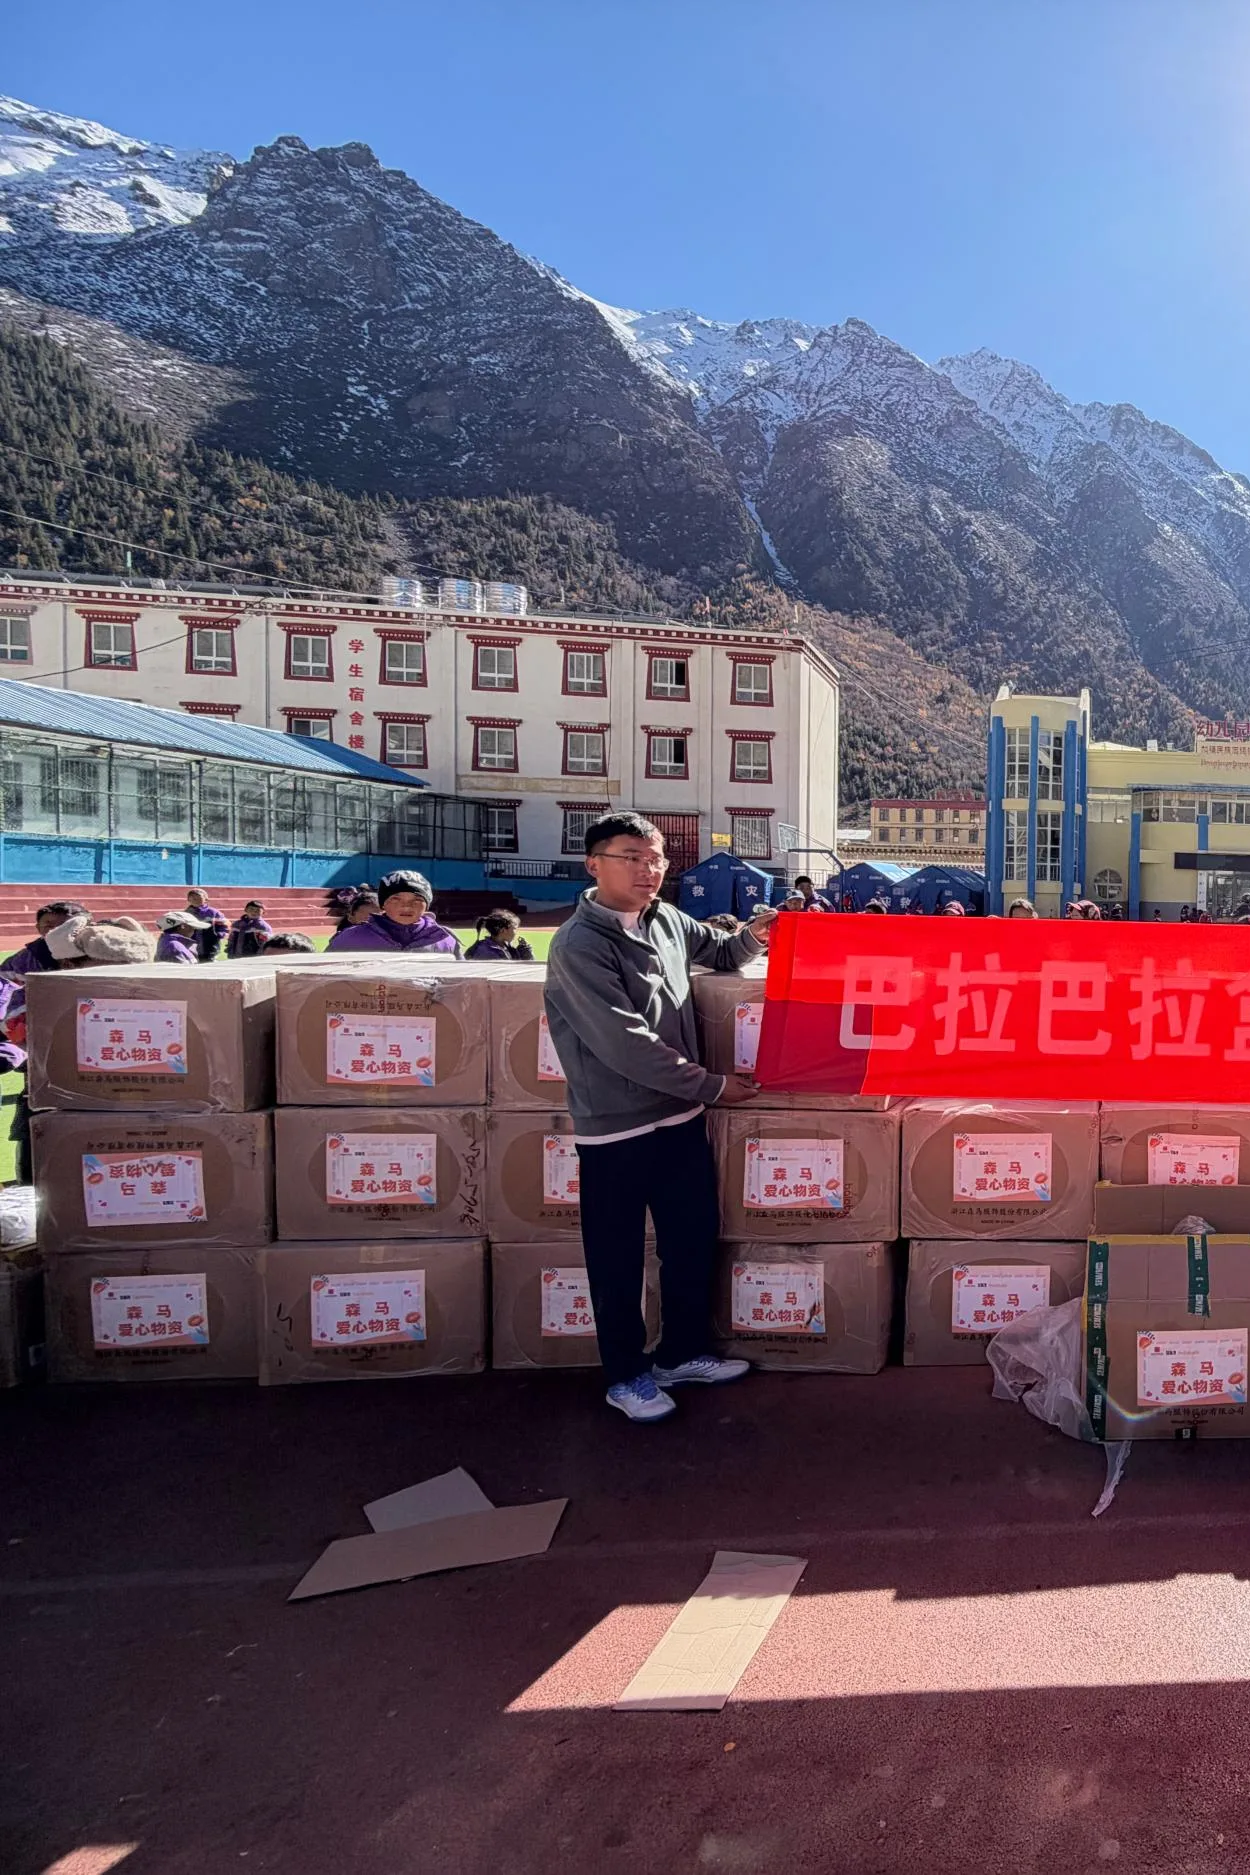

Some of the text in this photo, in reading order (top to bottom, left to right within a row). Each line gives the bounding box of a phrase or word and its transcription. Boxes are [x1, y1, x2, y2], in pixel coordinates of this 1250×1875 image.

[347, 638, 365, 750] 学生宿舍楼
[109, 1029, 152, 1045] 森马
[100, 1047, 162, 1062] 爱心物资
[360, 1043, 402, 1058] 森马
[350, 1060, 412, 1075] 爱心物资
[360, 1162, 403, 1177] 森马
[773, 1167, 813, 1181] 森马
[983, 1161, 1022, 1175] 森马
[1173, 1161, 1210, 1176] 森马
[120, 1180, 167, 1196] 森马
[351, 1179, 413, 1193] 爱心物资
[764, 1184, 821, 1198] 爱心物资
[975, 1177, 1030, 1191] 爱心物资
[759, 1291, 798, 1306] 森马
[982, 1293, 1020, 1307] 森马
[126, 1304, 172, 1320] 森马
[344, 1301, 390, 1317] 森马
[751, 1308, 806, 1322] 爱心物资
[118, 1320, 184, 1337] 爱心物资
[336, 1318, 401, 1335] 爱心物资
[1170, 1360, 1214, 1377] 森马
[1161, 1379, 1224, 1394] 爱心物资
